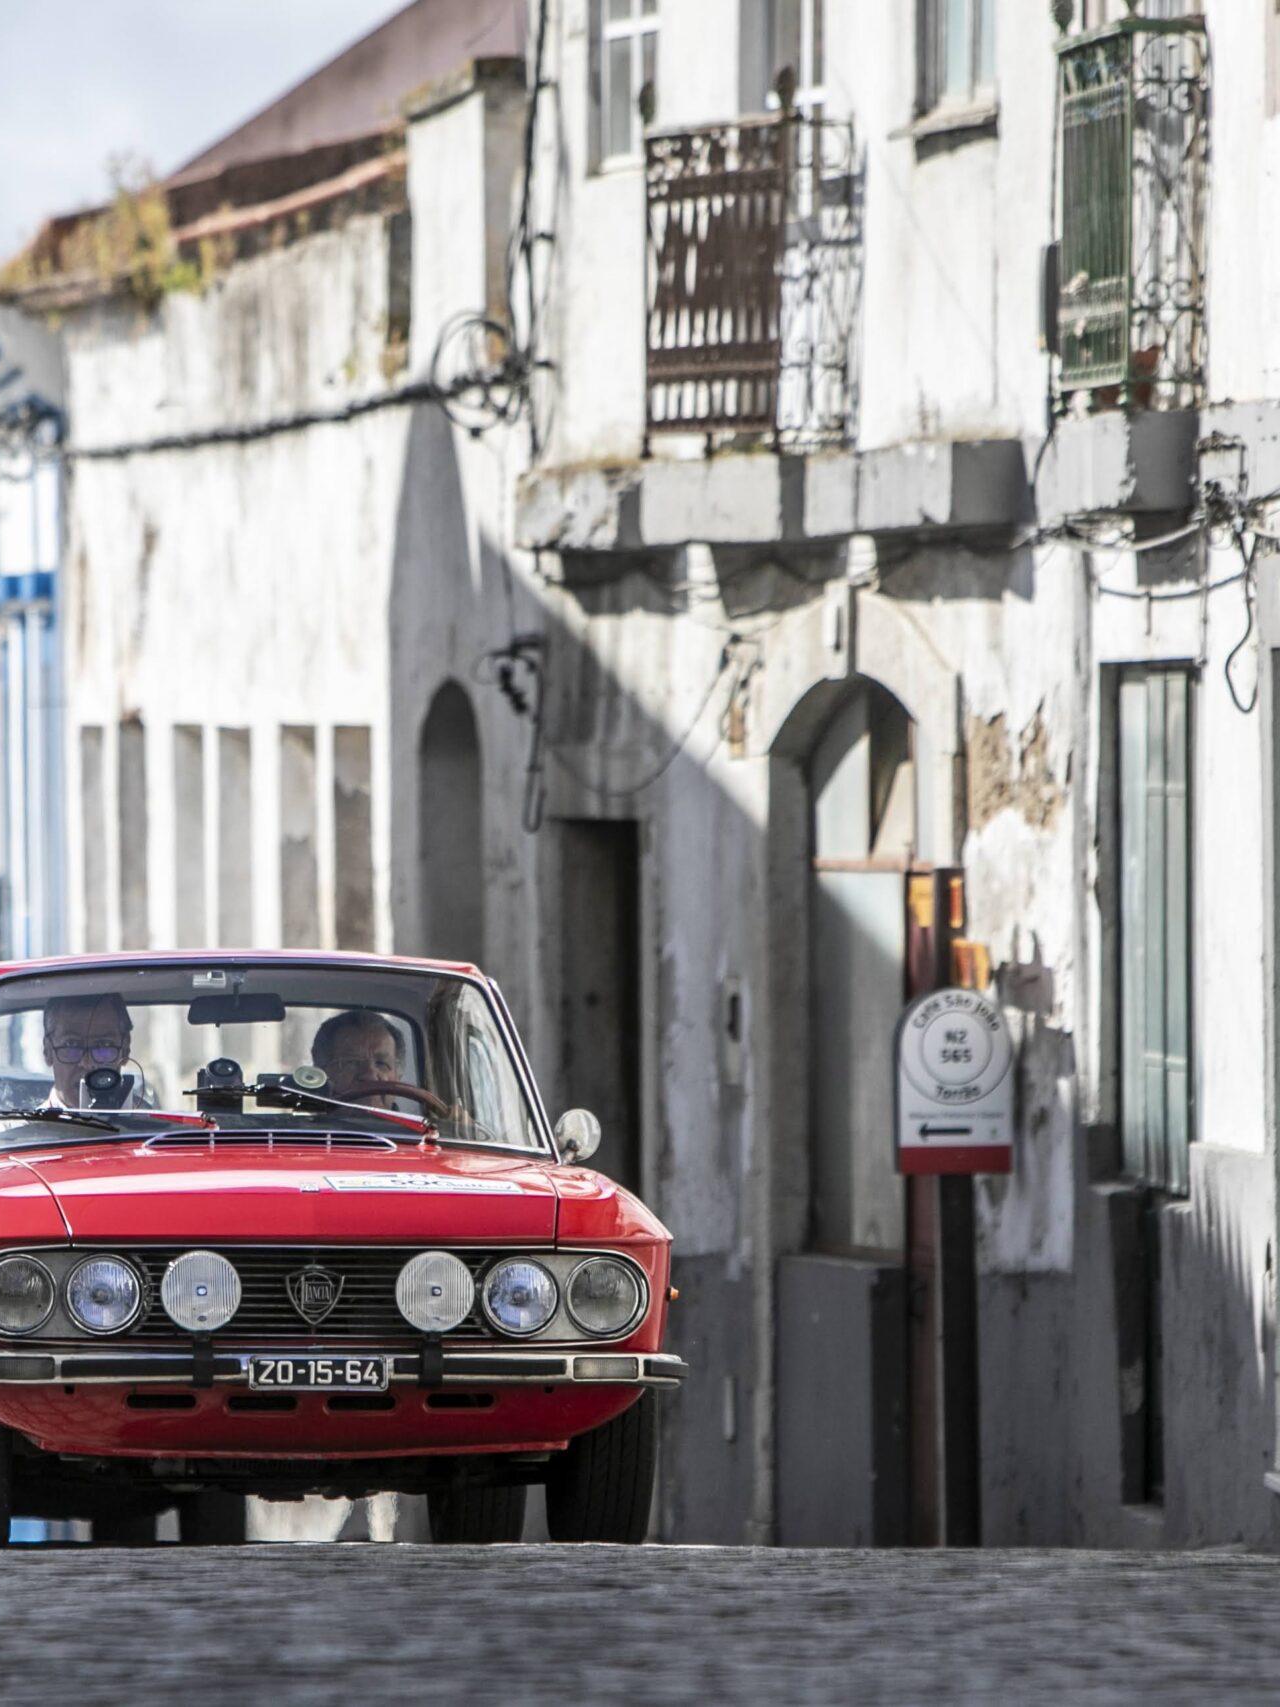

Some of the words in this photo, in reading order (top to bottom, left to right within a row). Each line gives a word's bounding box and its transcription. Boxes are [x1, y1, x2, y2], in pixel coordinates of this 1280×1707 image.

[913, 999, 941, 1029] Café
[944, 995, 973, 1008] São
[974, 1001, 1000, 1031] João
[944, 1029, 968, 1044] N2
[940, 1049, 972, 1063] 565
[936, 1085, 981, 1099] Torrão
[305, 1283, 330, 1302] LANCIA
[258, 1361, 379, 1385] ZO-15-64
